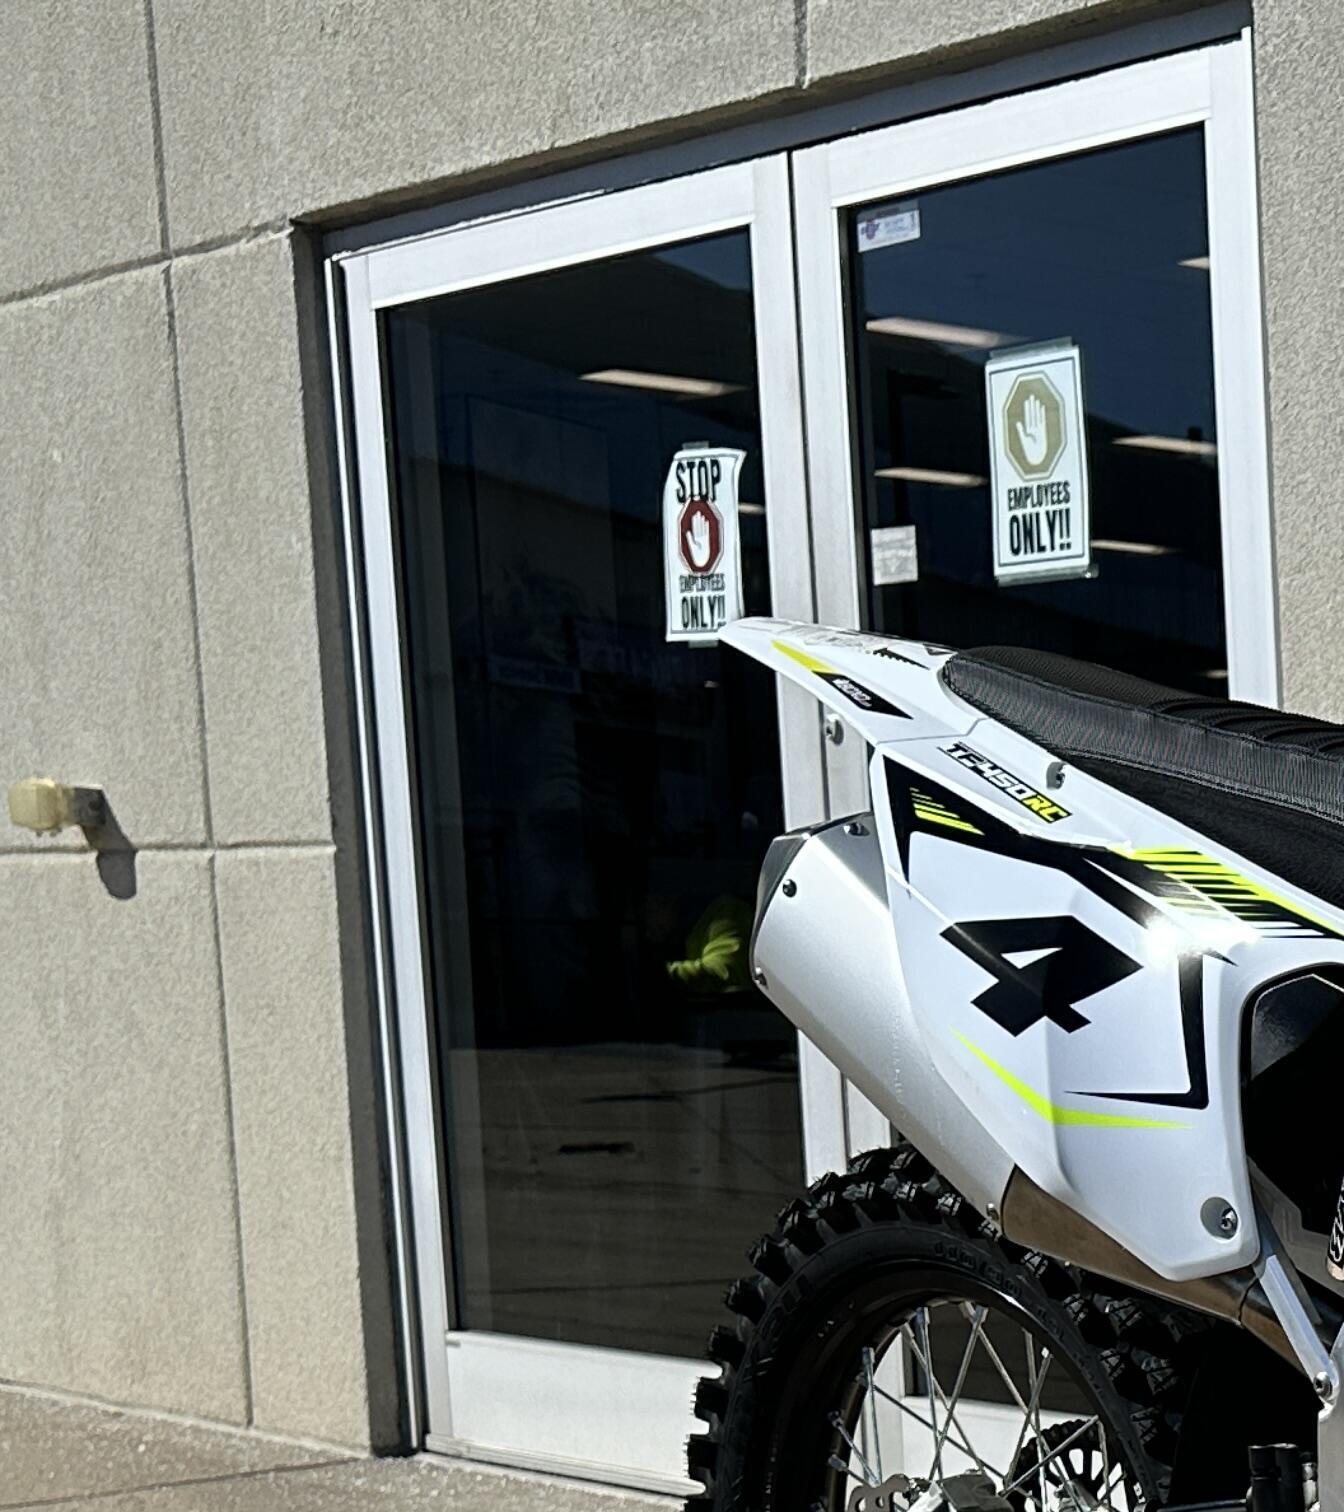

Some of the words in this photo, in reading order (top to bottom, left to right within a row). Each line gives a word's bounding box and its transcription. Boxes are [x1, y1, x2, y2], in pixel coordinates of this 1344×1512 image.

[676, 459, 721, 503] STOP
[1008, 480, 1070, 511] EMPLOYEES
[1009, 508, 1071, 556] ONLY!!
[681, 595, 727, 628] ONLY!!
[939, 915, 1143, 1037] 4
